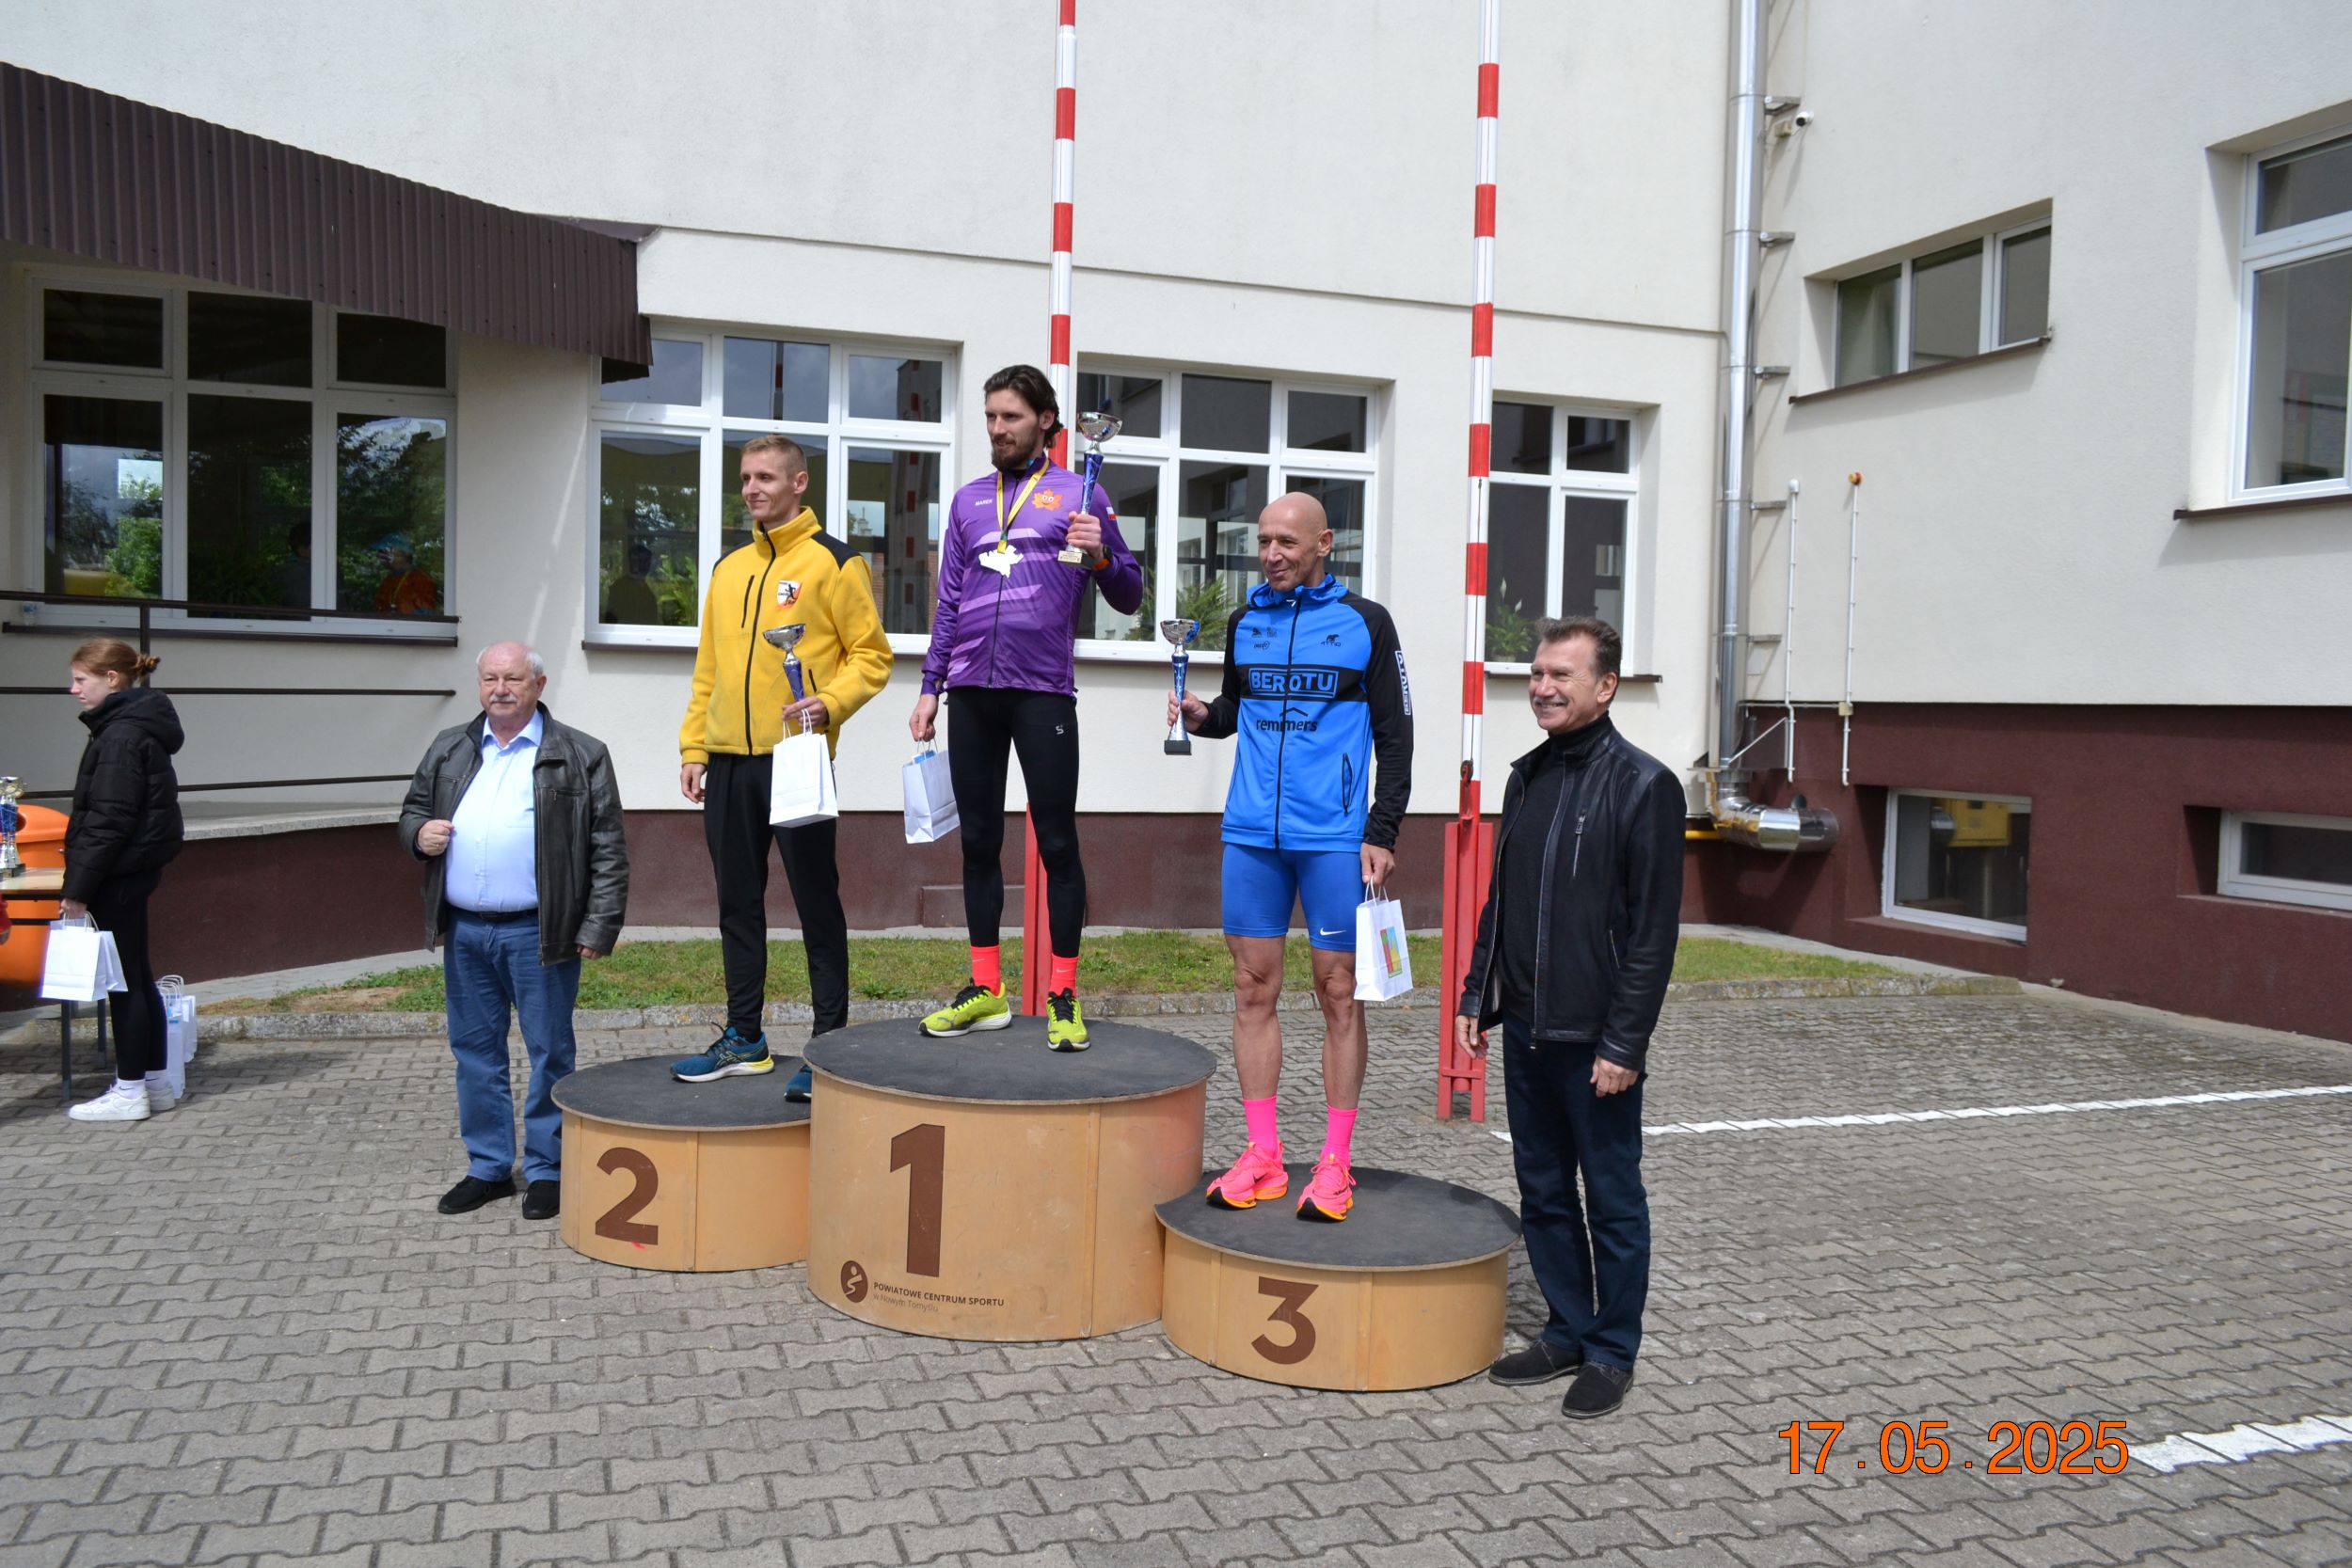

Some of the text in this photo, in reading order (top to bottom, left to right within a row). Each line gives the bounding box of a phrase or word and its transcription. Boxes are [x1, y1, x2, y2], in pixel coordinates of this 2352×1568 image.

[1250, 671, 1334, 692] BEROTU
[595, 1146, 660, 1246] 2
[889, 1123, 946, 1277] 1
[873, 1281, 1005, 1307] POWIATOWE CENTRUM SPORTU
[881, 1294, 906, 1307] Nowym
[1250, 1275, 1319, 1365] 3
